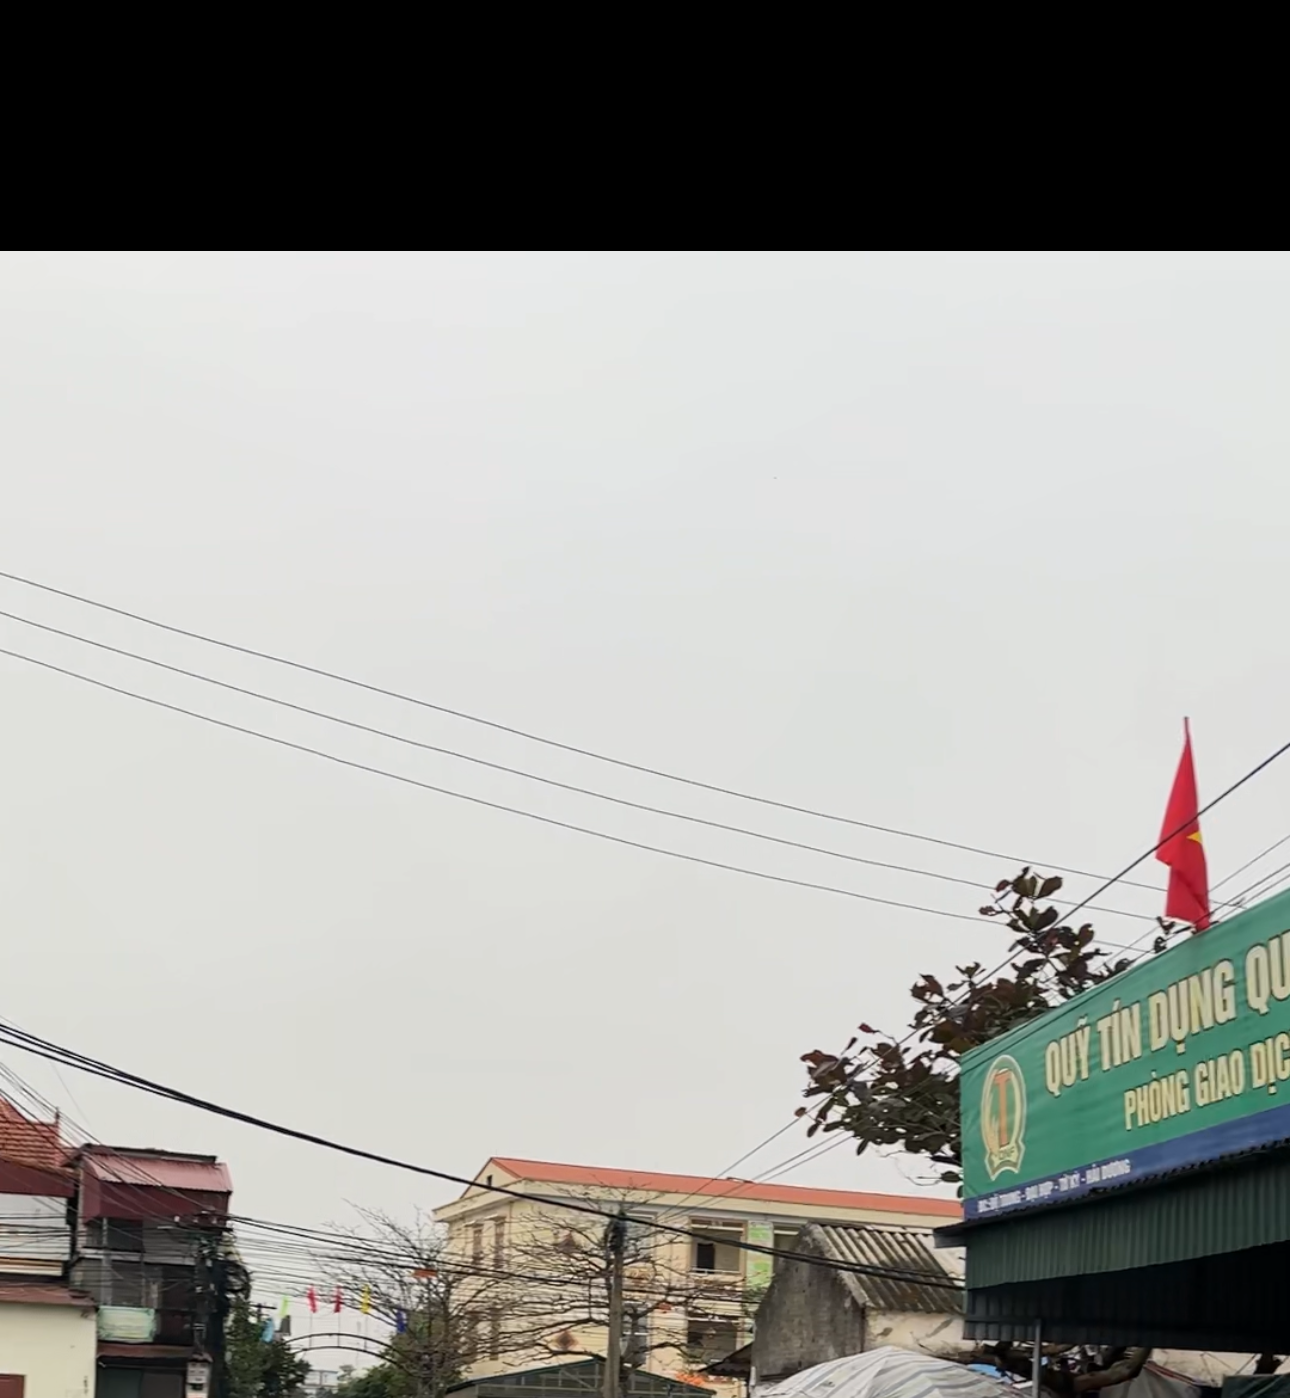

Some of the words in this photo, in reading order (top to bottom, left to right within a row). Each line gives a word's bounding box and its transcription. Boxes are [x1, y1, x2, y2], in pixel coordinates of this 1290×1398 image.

[1045, 1015, 1090, 1097] QUỸ
[1097, 998, 1142, 1072] TÍN
[1148, 958, 1236, 1055] DỤNG
[1123, 1070, 1191, 1131] PHÒNG
[1194, 1049, 1245, 1107] GIAO
